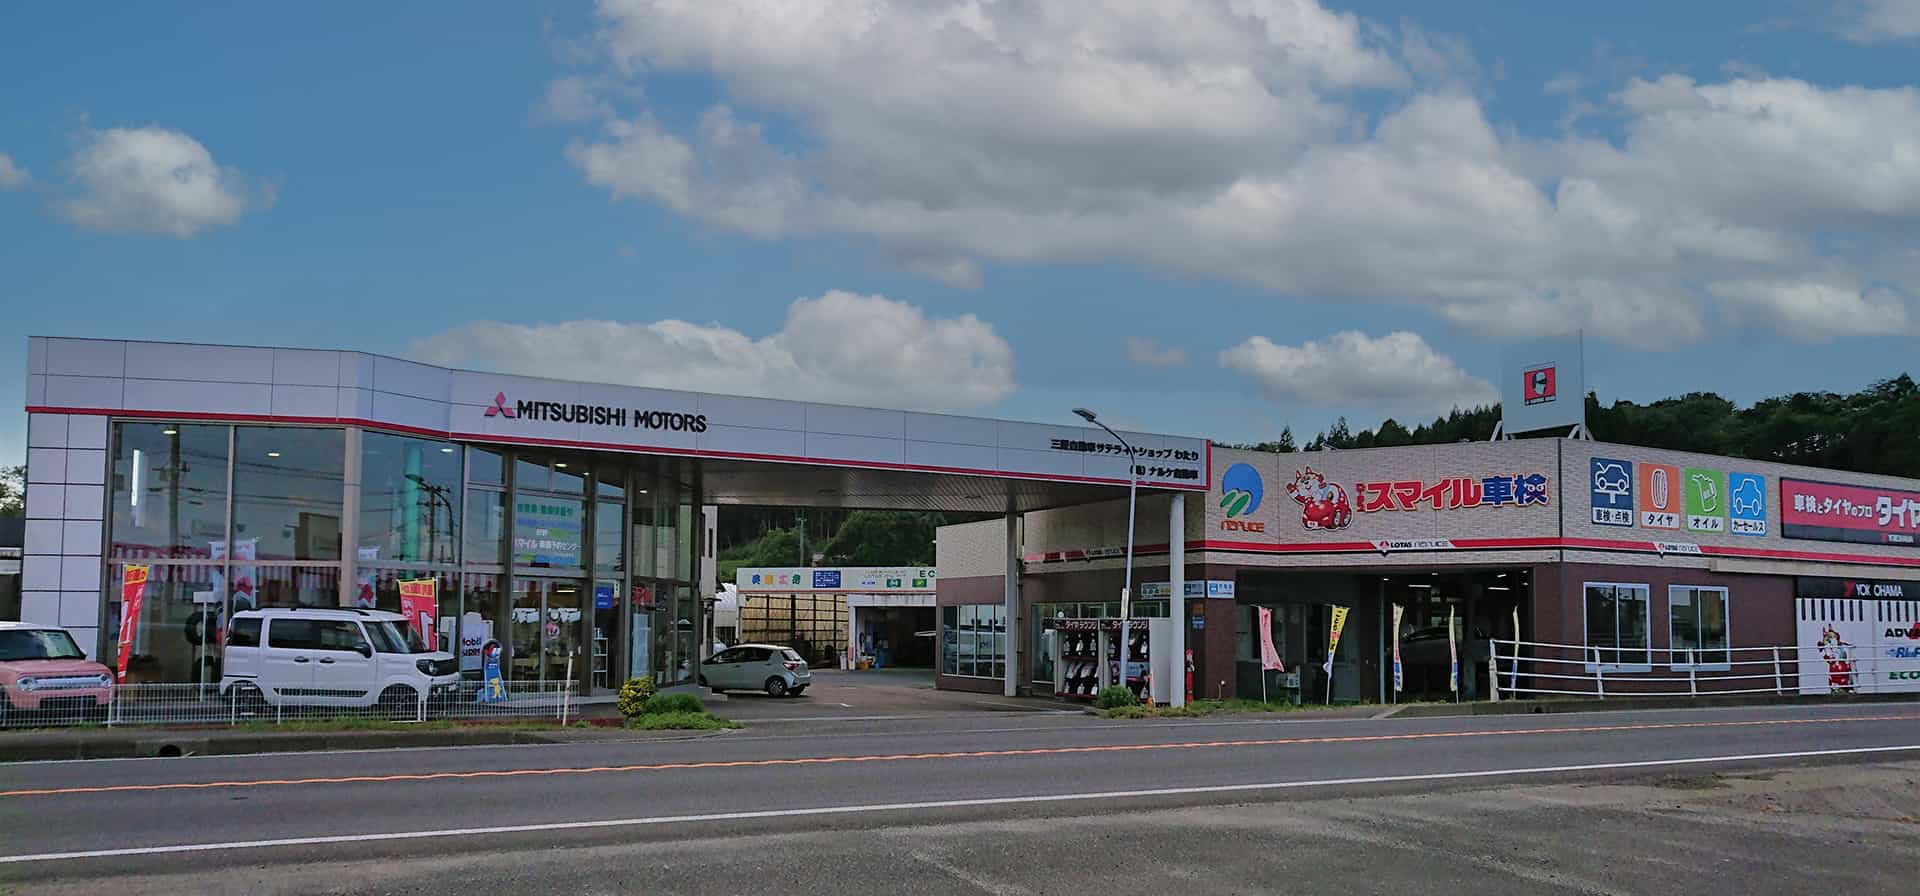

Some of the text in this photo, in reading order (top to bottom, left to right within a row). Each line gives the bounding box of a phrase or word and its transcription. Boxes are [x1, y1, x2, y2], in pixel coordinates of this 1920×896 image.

[516, 400, 707, 433] MITSUBISHI MOTORS
[1174, 450, 1199, 461] わたり
[1366, 474, 1549, 512] スマイル車検
[1794, 493, 1873, 518] 車検とタイヤのプロ
[1595, 509, 1631, 523] 車検・点検
[1647, 513, 1674, 526] タイヤ
[1692, 518, 1719, 530] オイル
[1733, 520, 1764, 533] カーセールス
[1390, 541, 1412, 549] LOTAS
[1111, 621, 1148, 630] タイラウンジ
